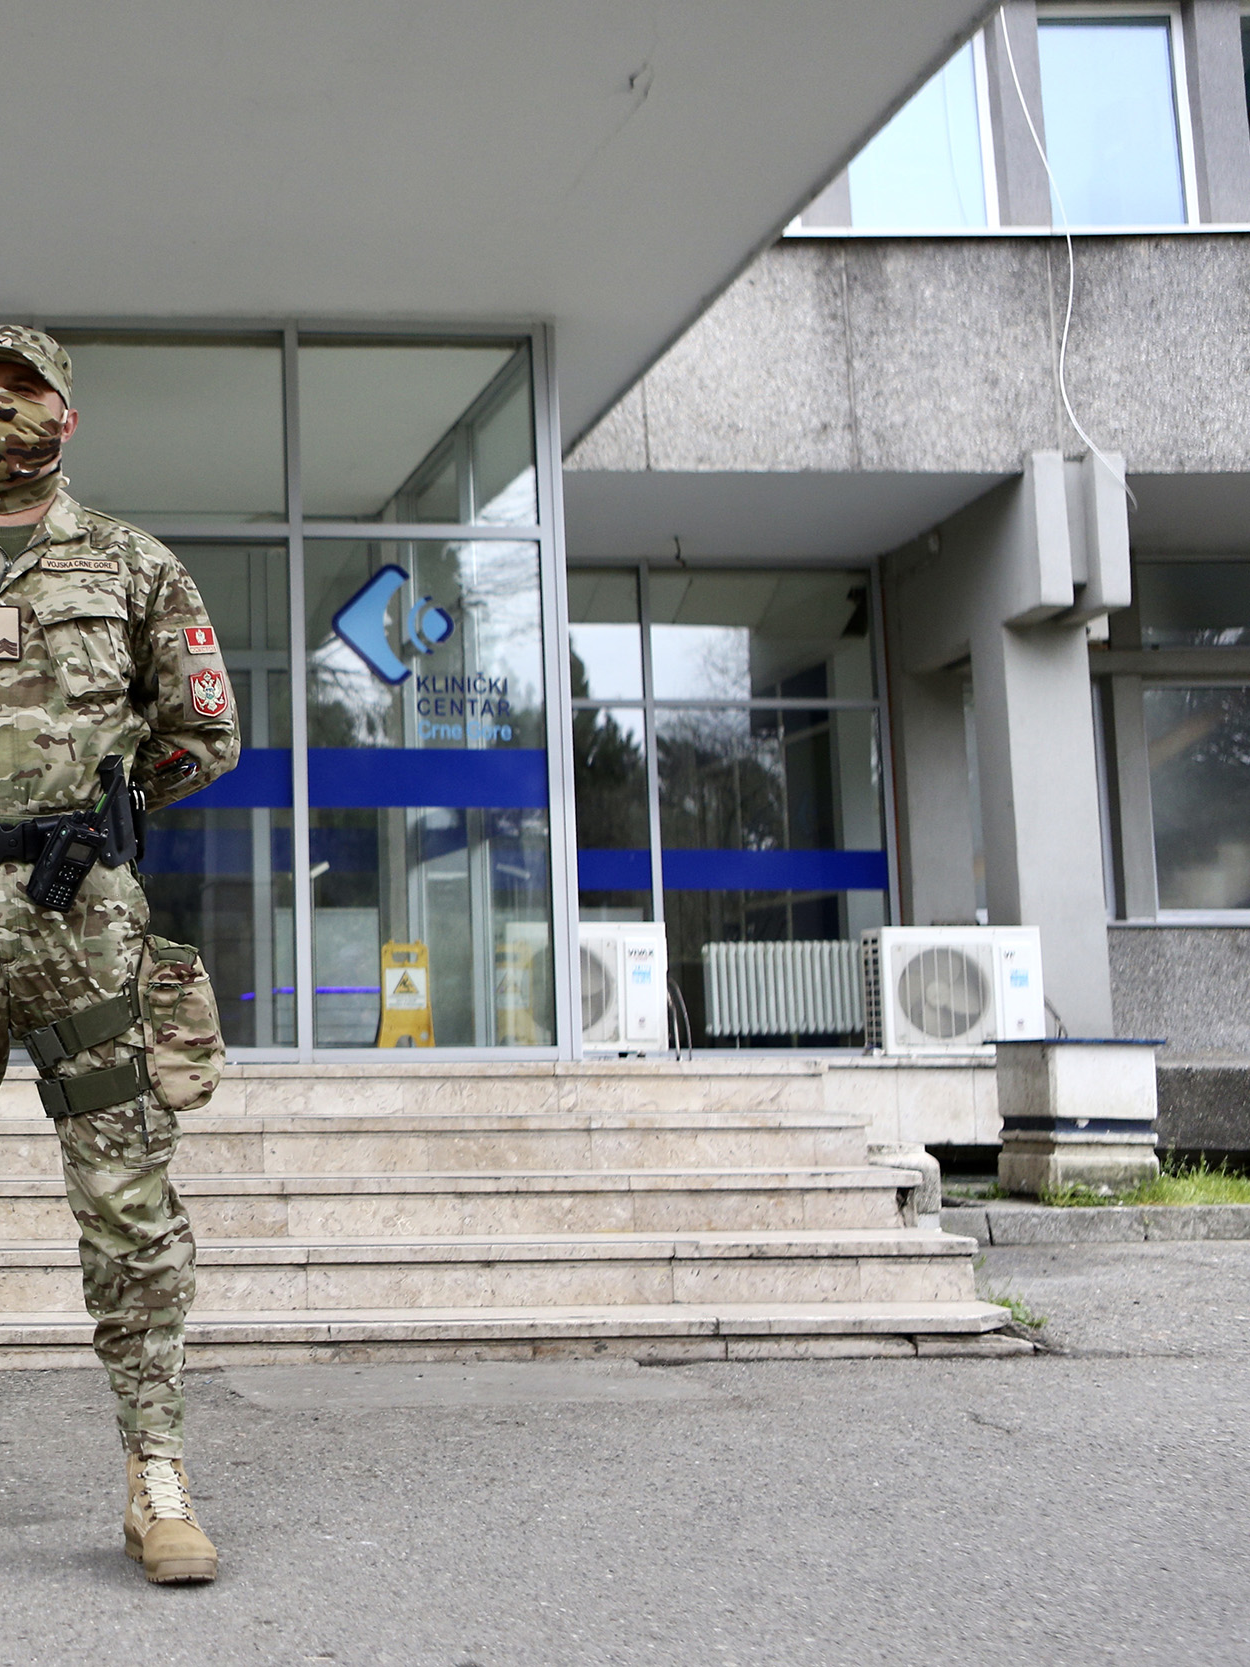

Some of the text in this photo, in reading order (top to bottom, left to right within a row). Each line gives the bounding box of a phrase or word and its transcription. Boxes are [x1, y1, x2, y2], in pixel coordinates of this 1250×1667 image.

[74, 560, 93, 568] CRNE
[416, 672, 508, 694] KLINIČKI
[417, 698, 510, 716] CENTAR
[418, 720, 512, 741] Crne Gore
